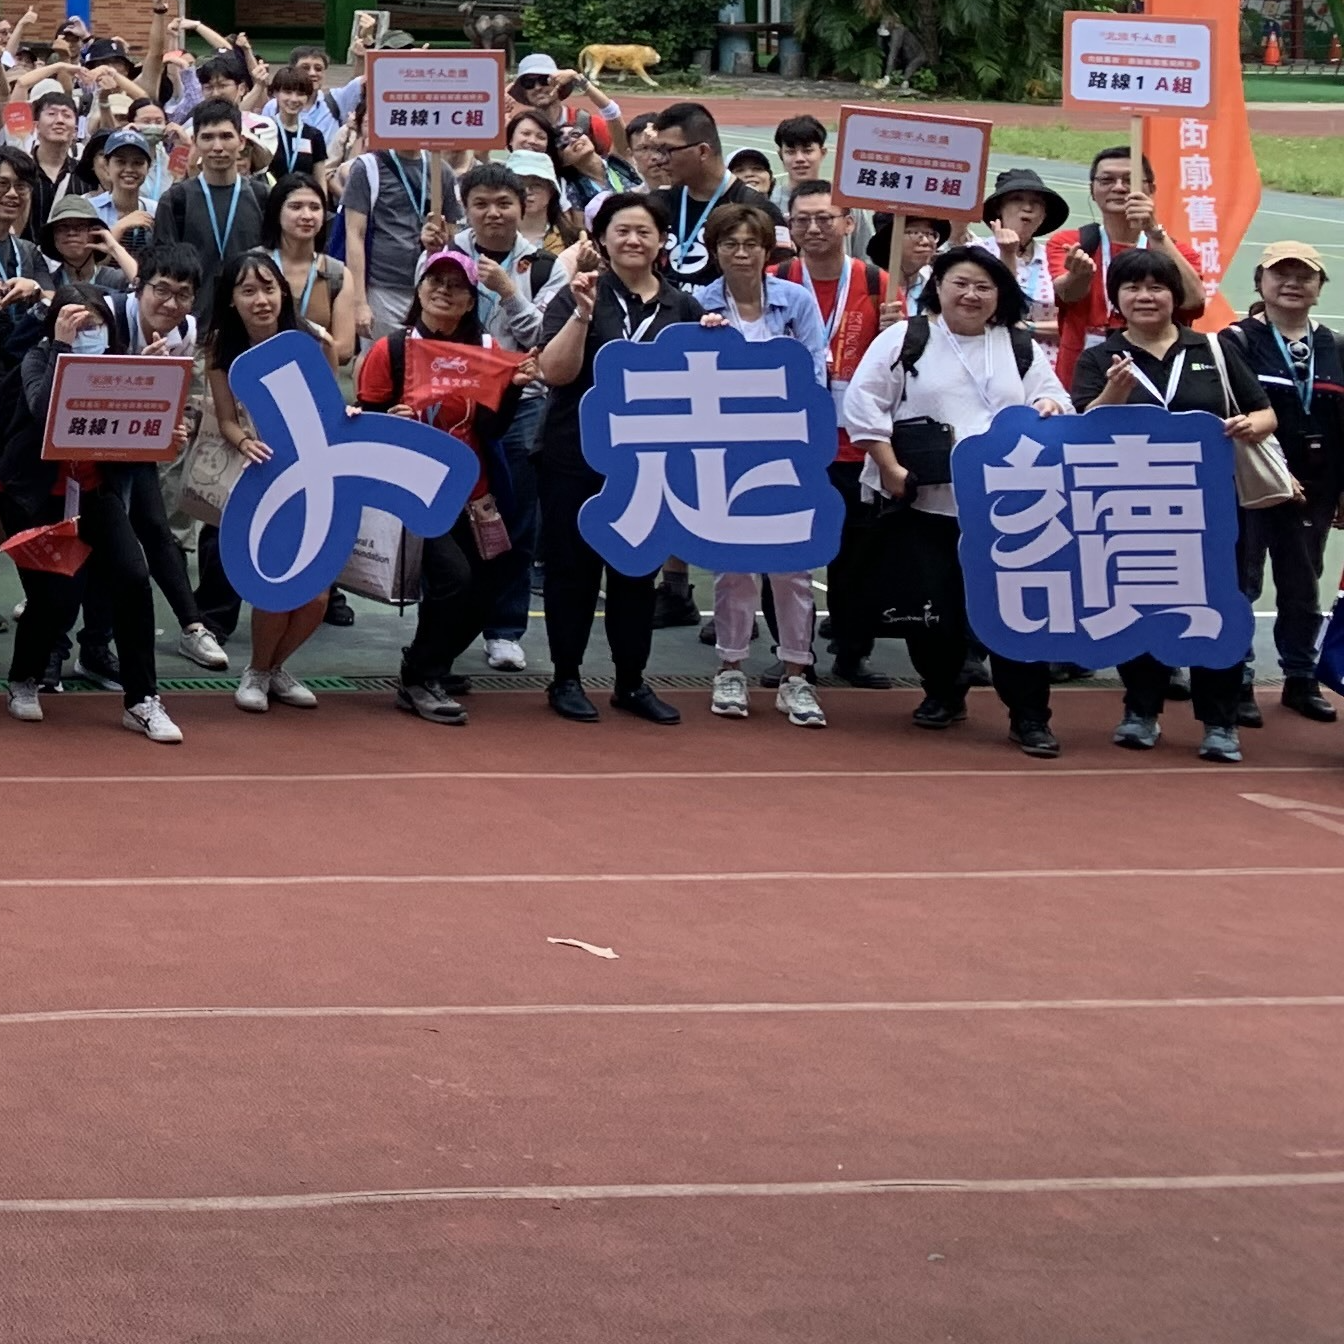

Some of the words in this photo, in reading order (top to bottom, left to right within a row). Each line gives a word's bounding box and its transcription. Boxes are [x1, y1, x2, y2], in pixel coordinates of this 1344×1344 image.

[1088, 71, 1144, 91] 路線1
[1155, 76, 1193, 94] A組
[389, 109, 440, 127] 路線1
[451, 109, 484, 127] C組
[857, 167, 914, 189] 路線1
[925, 176, 962, 196] B組
[68, 417, 119, 436] 路線1
[128, 418, 162, 436] D組
